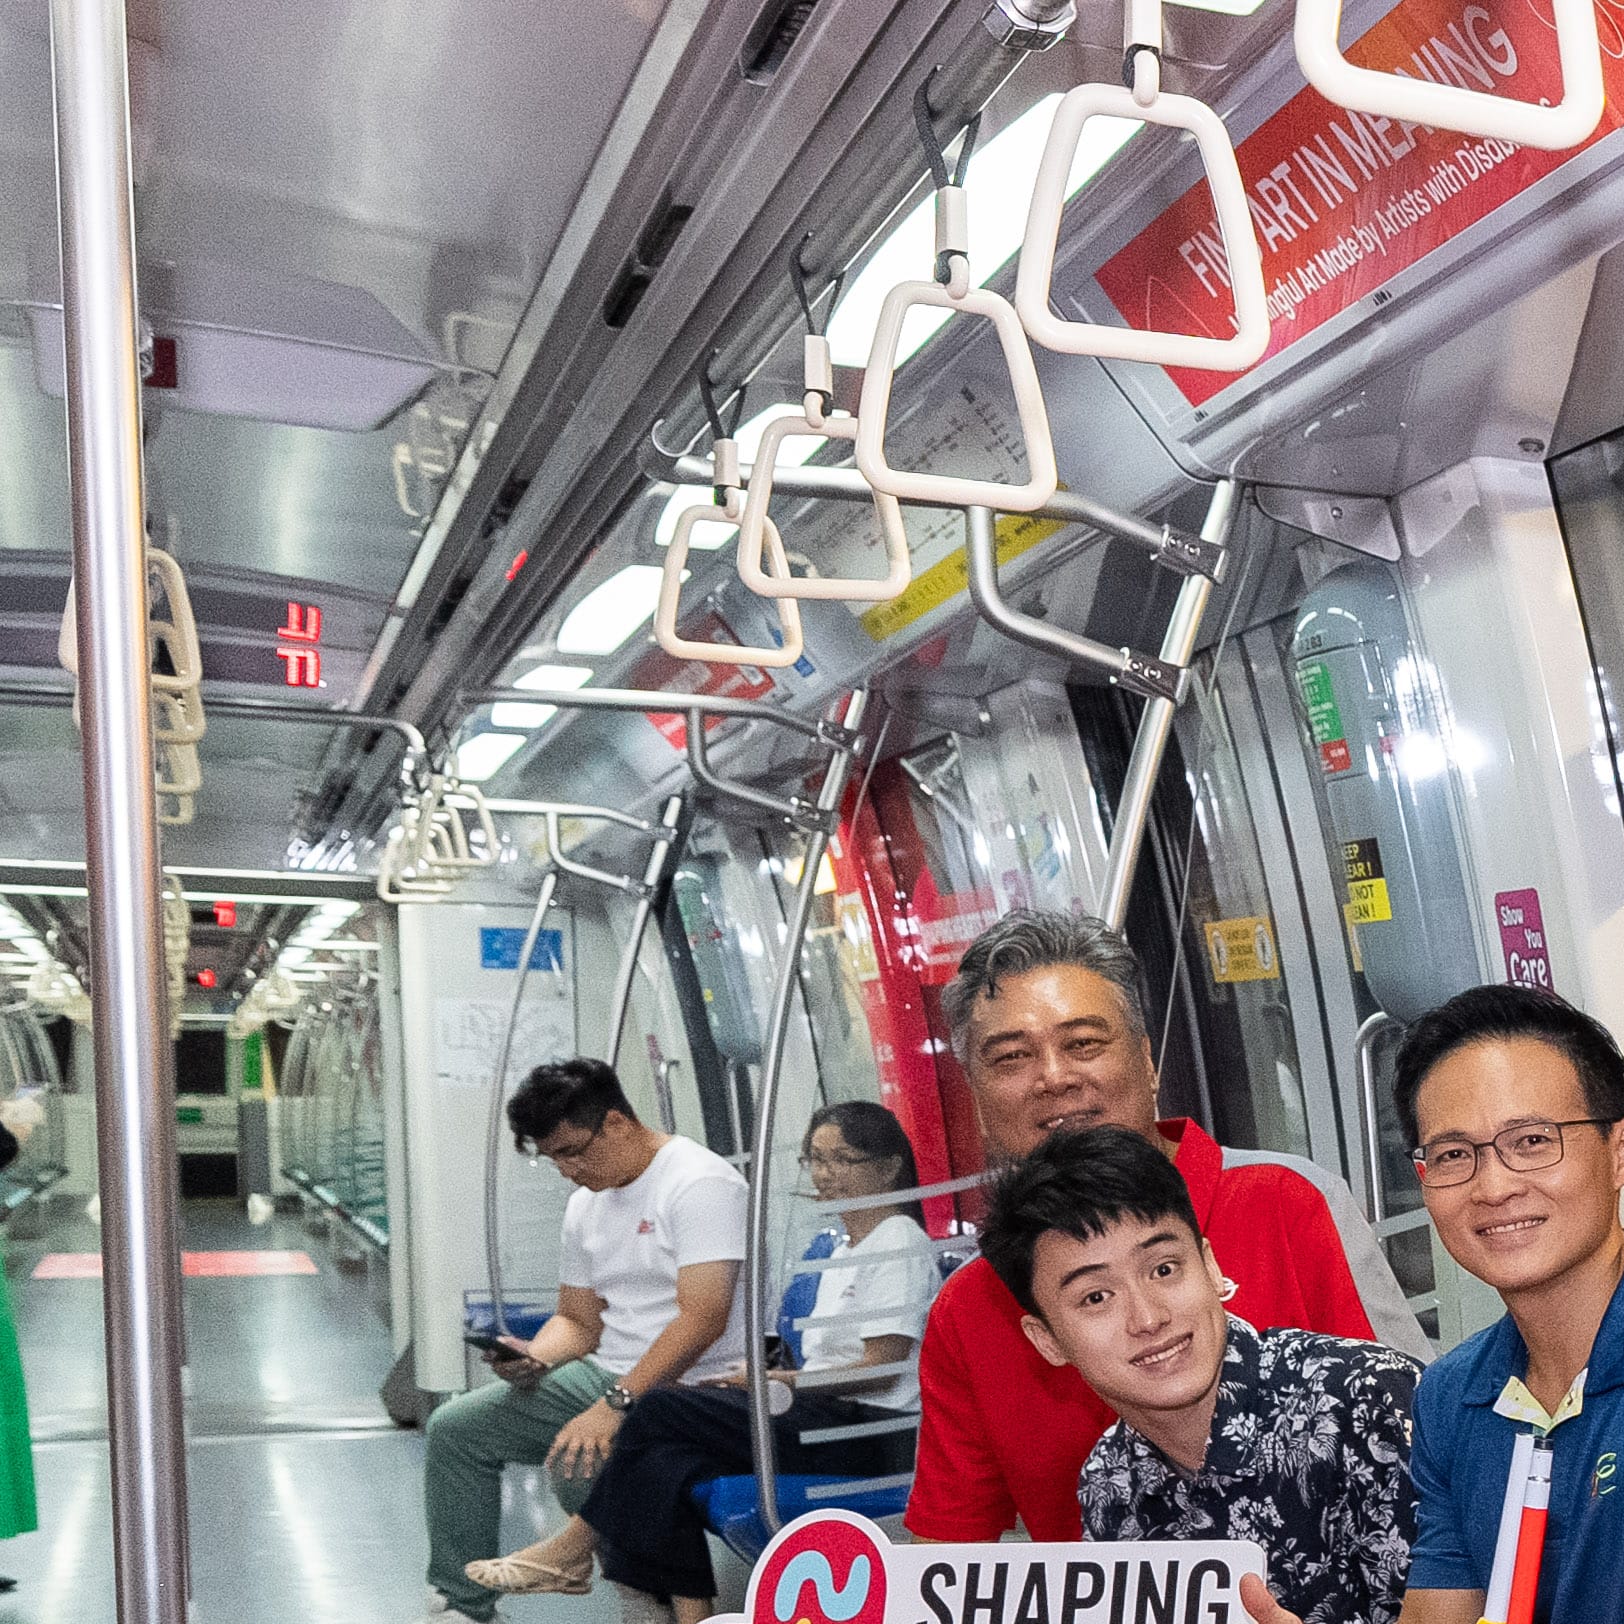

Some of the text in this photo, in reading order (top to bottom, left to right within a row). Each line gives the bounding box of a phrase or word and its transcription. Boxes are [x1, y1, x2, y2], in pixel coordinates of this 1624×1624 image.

[1178, 218, 1248, 298] FIN
[1247, 161, 1319, 253] ART
[1293, 134, 1358, 210] IN
[1297, 255, 1327, 299] Art
[1318, 230, 1363, 281] Made
[1355, 223, 1388, 257] by
[1375, 190, 1432, 239] Artists
[1422, 160, 1461, 206] with
[1500, 904, 1524, 927] Show
[1524, 928, 1543, 949] You
[1510, 951, 1548, 988] Care
